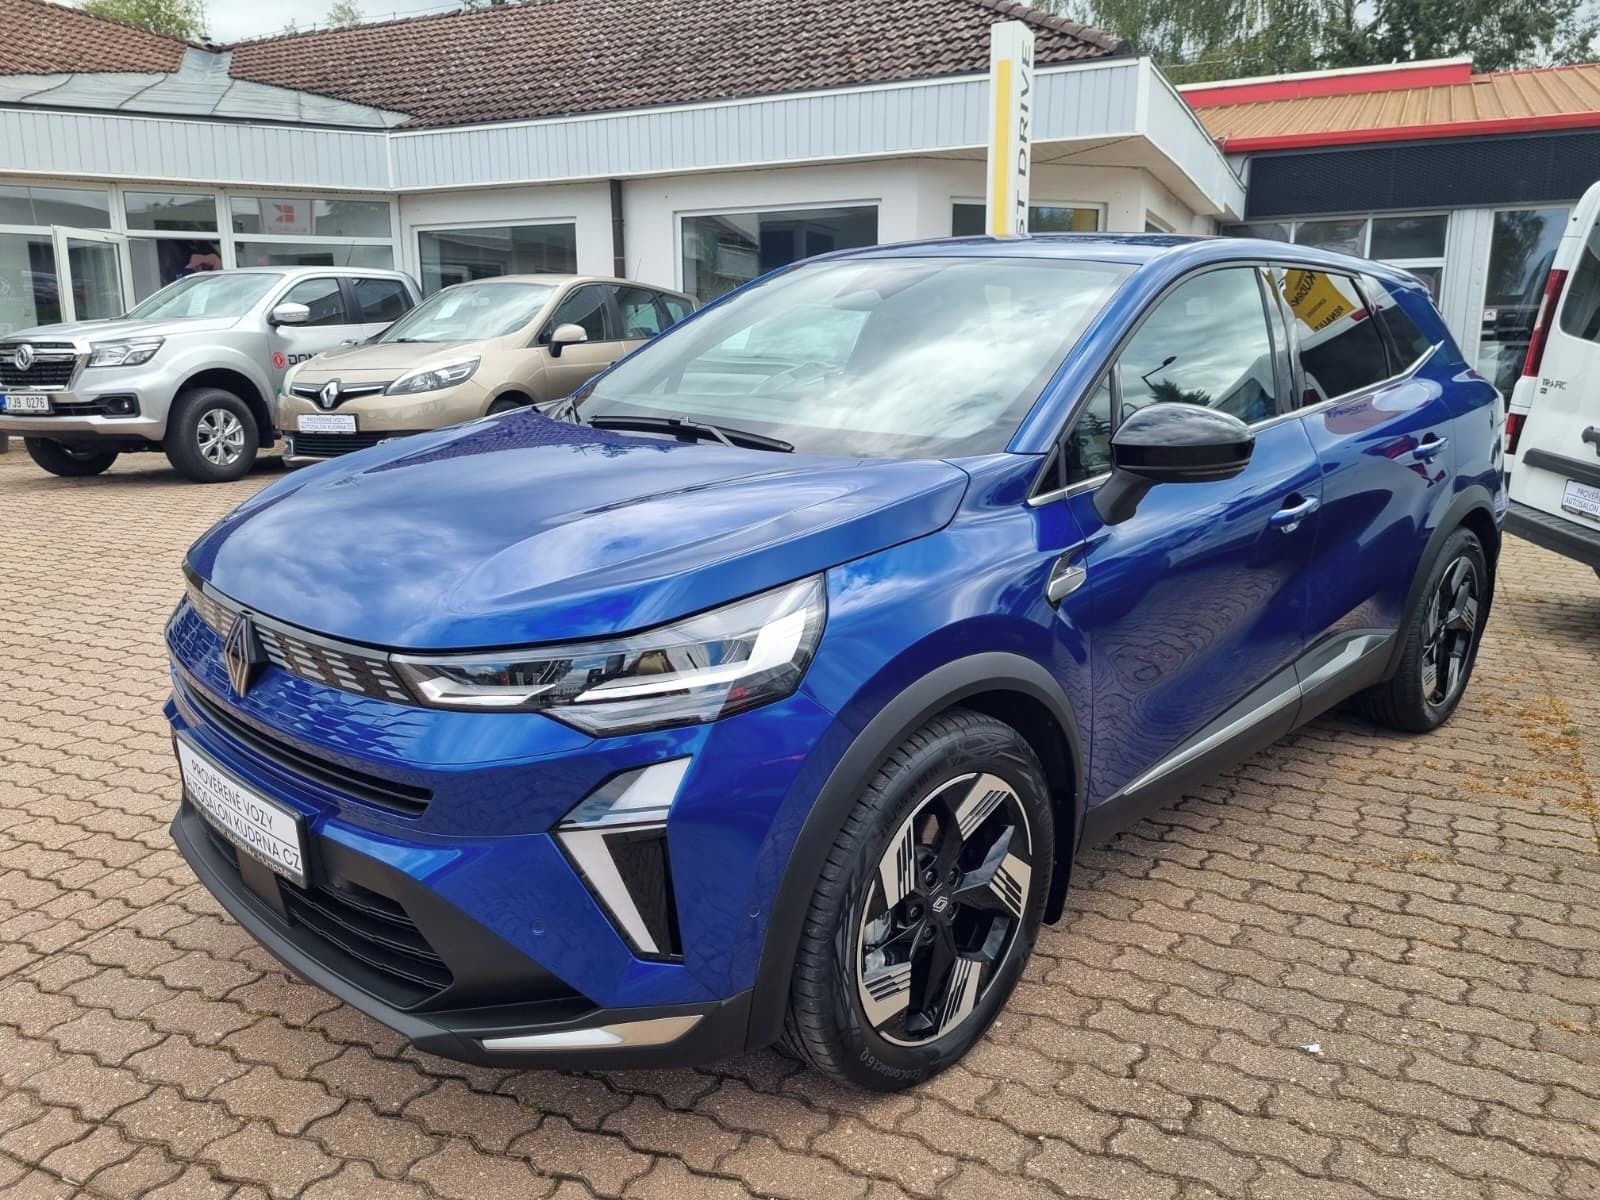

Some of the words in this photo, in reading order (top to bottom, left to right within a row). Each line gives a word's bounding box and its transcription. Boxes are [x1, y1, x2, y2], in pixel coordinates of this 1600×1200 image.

[1018, 40, 1030, 176] DRIVE
[26, 396, 45, 408] 0276
[186, 775, 233, 826] AUTOSALON
[234, 815, 281, 859] KUDRNA
[282, 848, 302, 872] CZ
[191, 759, 242, 810] PROVĚŘENÉ
[242, 801, 273, 830] VOZY
